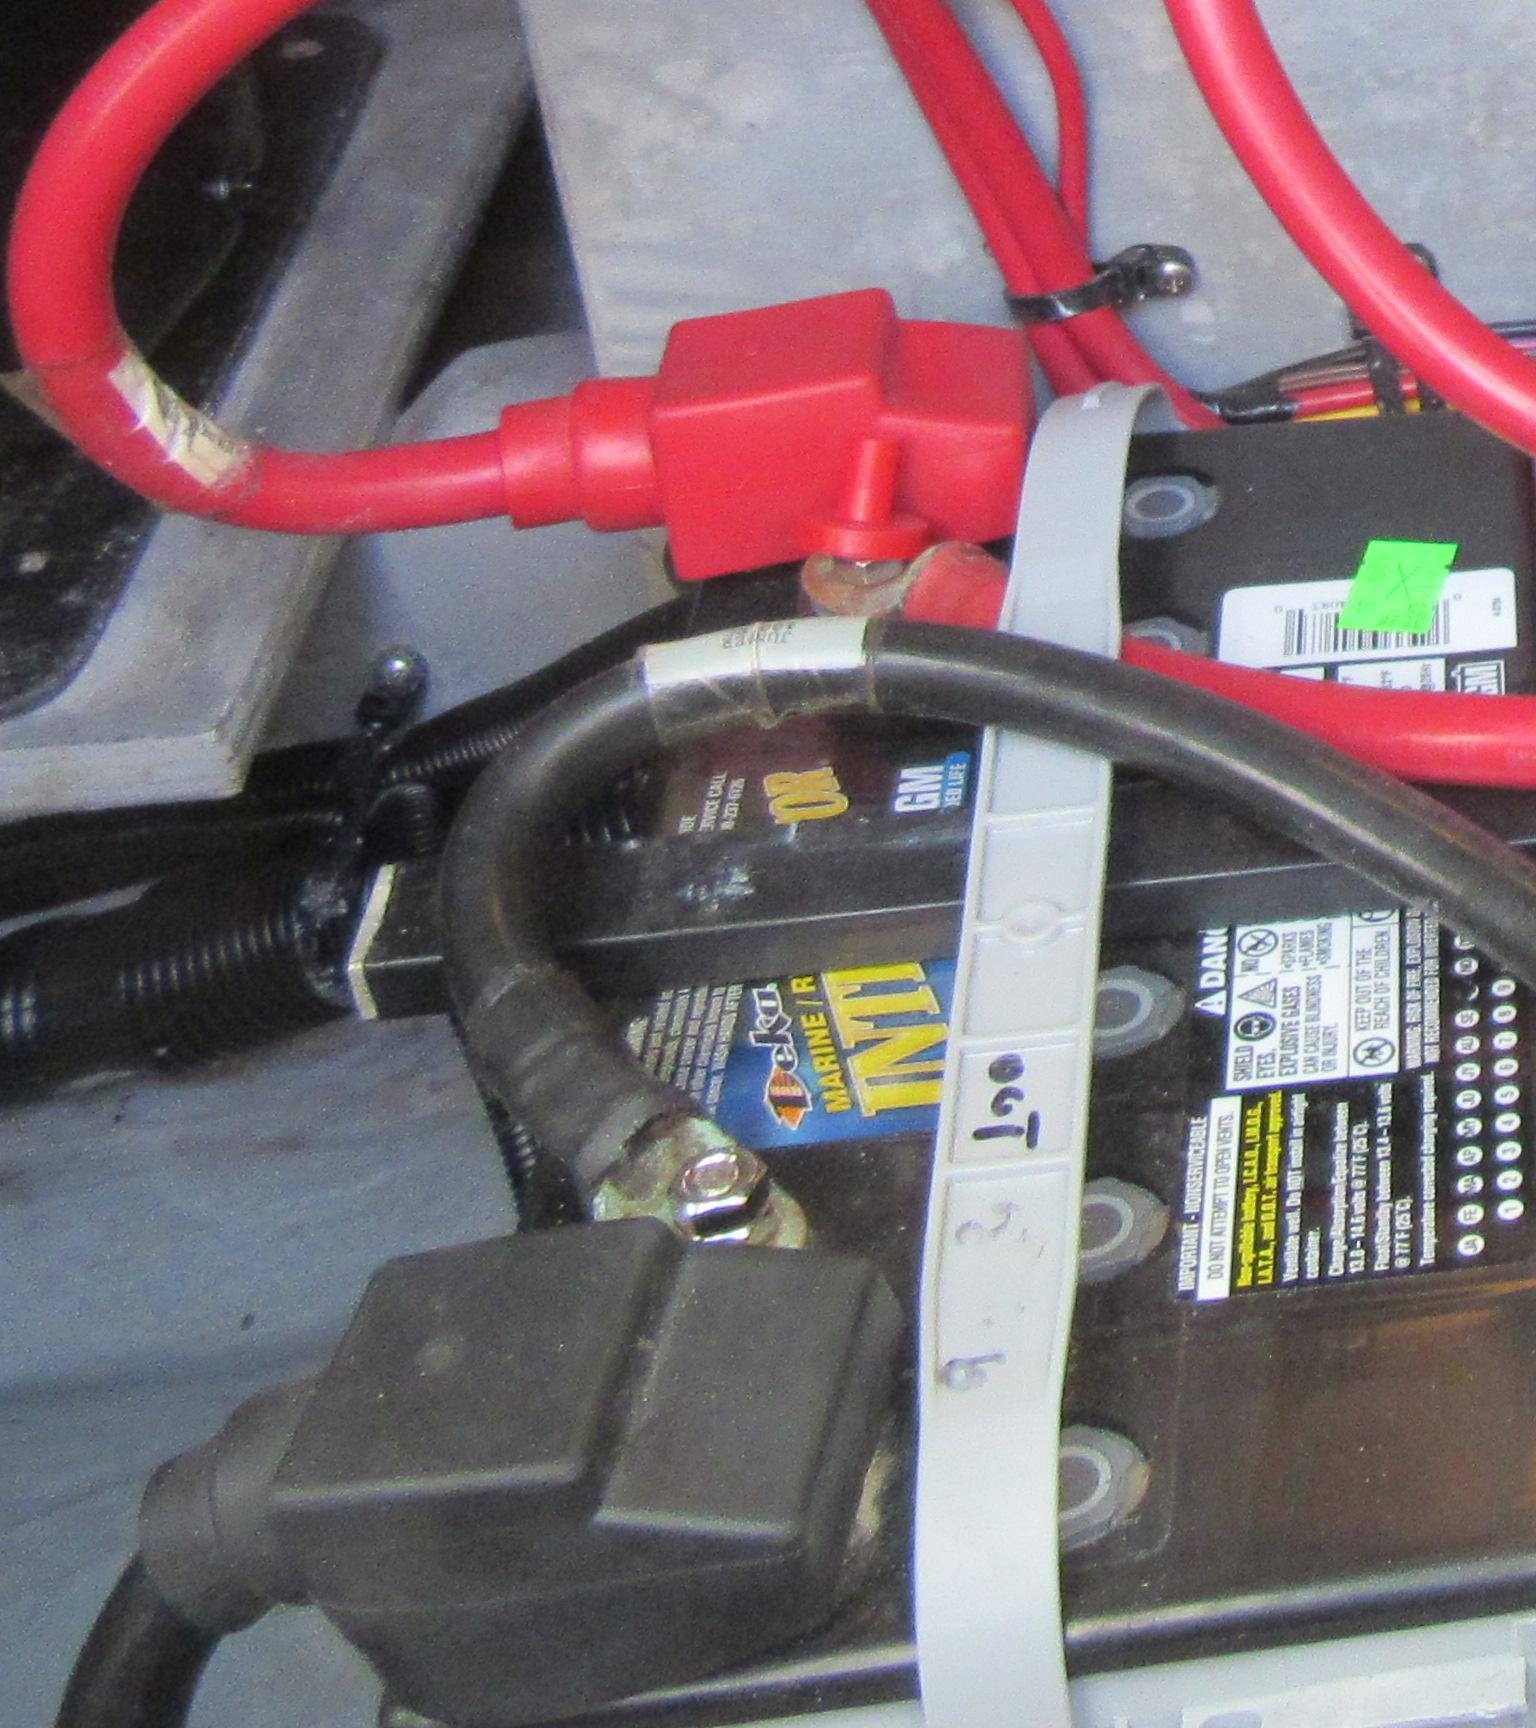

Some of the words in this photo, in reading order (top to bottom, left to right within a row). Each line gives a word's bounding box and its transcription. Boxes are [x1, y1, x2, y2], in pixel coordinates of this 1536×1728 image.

[1355, 948, 1371, 965] THE
[790, 975, 816, 995] R
[1354, 968, 1371, 981] OF
[1373, 980, 1390, 993] OF
[1281, 984, 1300, 1018] GASES
[1354, 983, 1371, 1004] OUT
[1353, 1006, 1370, 1031] KEEP
[1372, 995, 1390, 1030] REACH
[1278, 1019, 1299, 1077] EXPLOSIVE
[807, 1010, 853, 1115] MARINE
[1233, 1044, 1253, 1082] SHIELD
[972, 1052, 1041, 1149] OCT
[1216, 1111, 1234, 1146] VENTS.
[1377, 1135, 1391, 1158] 13.4
[1184, 1115, 1207, 1213] NONSERVICEABLE
[1214, 1146, 1231, 1174] OPEN
[1213, 1175, 1229, 1189] TO
[1287, 1168, 1304, 1191] NOT
[1210, 1190, 1228, 1237] ATTEMPT
[1350, 1214, 1365, 1238] 14.6
[1178, 1221, 1199, 1291] IMPORTANT
[1208, 1239, 1226, 1261] NOT
[1350, 1248, 1364, 1273] 13.8
[1207, 1262, 1224, 1280] DO
